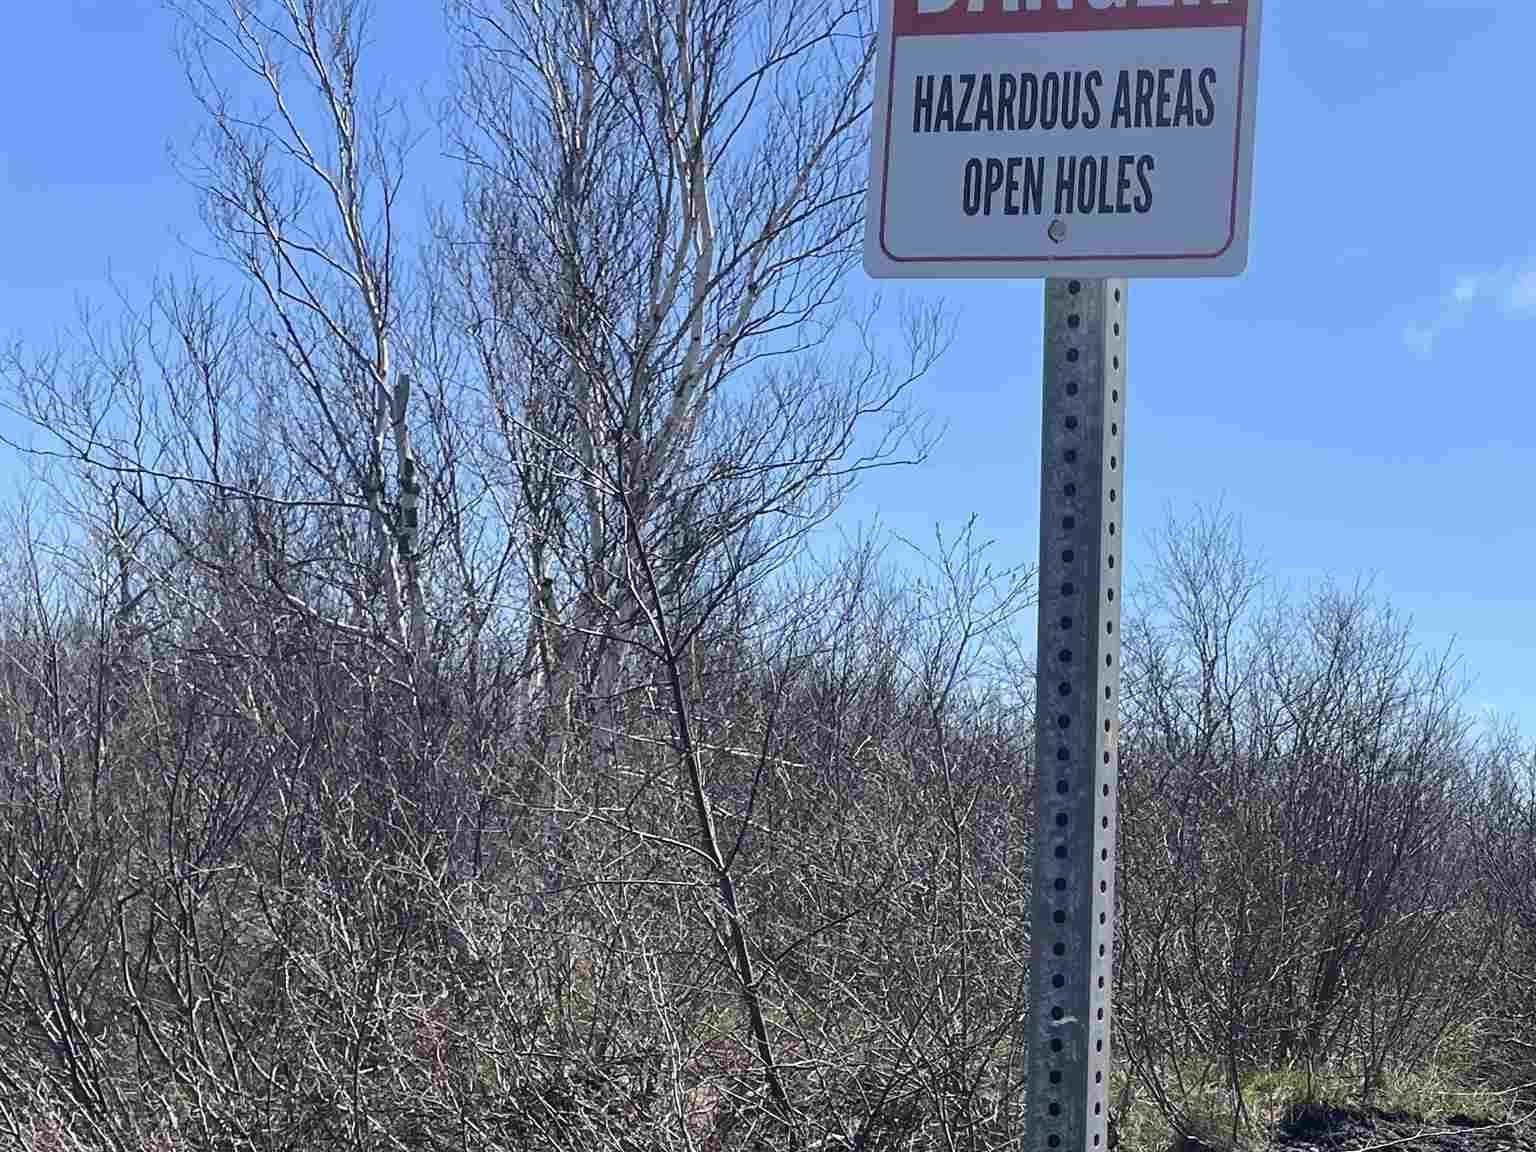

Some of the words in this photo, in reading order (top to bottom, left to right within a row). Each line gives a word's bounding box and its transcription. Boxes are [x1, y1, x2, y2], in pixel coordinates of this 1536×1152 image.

[912, 70, 1104, 133] HAZARDOUS
[1110, 67, 1217, 129] AREAS
[962, 156, 1046, 217] OPEN
[1054, 154, 1155, 215] HOLES
